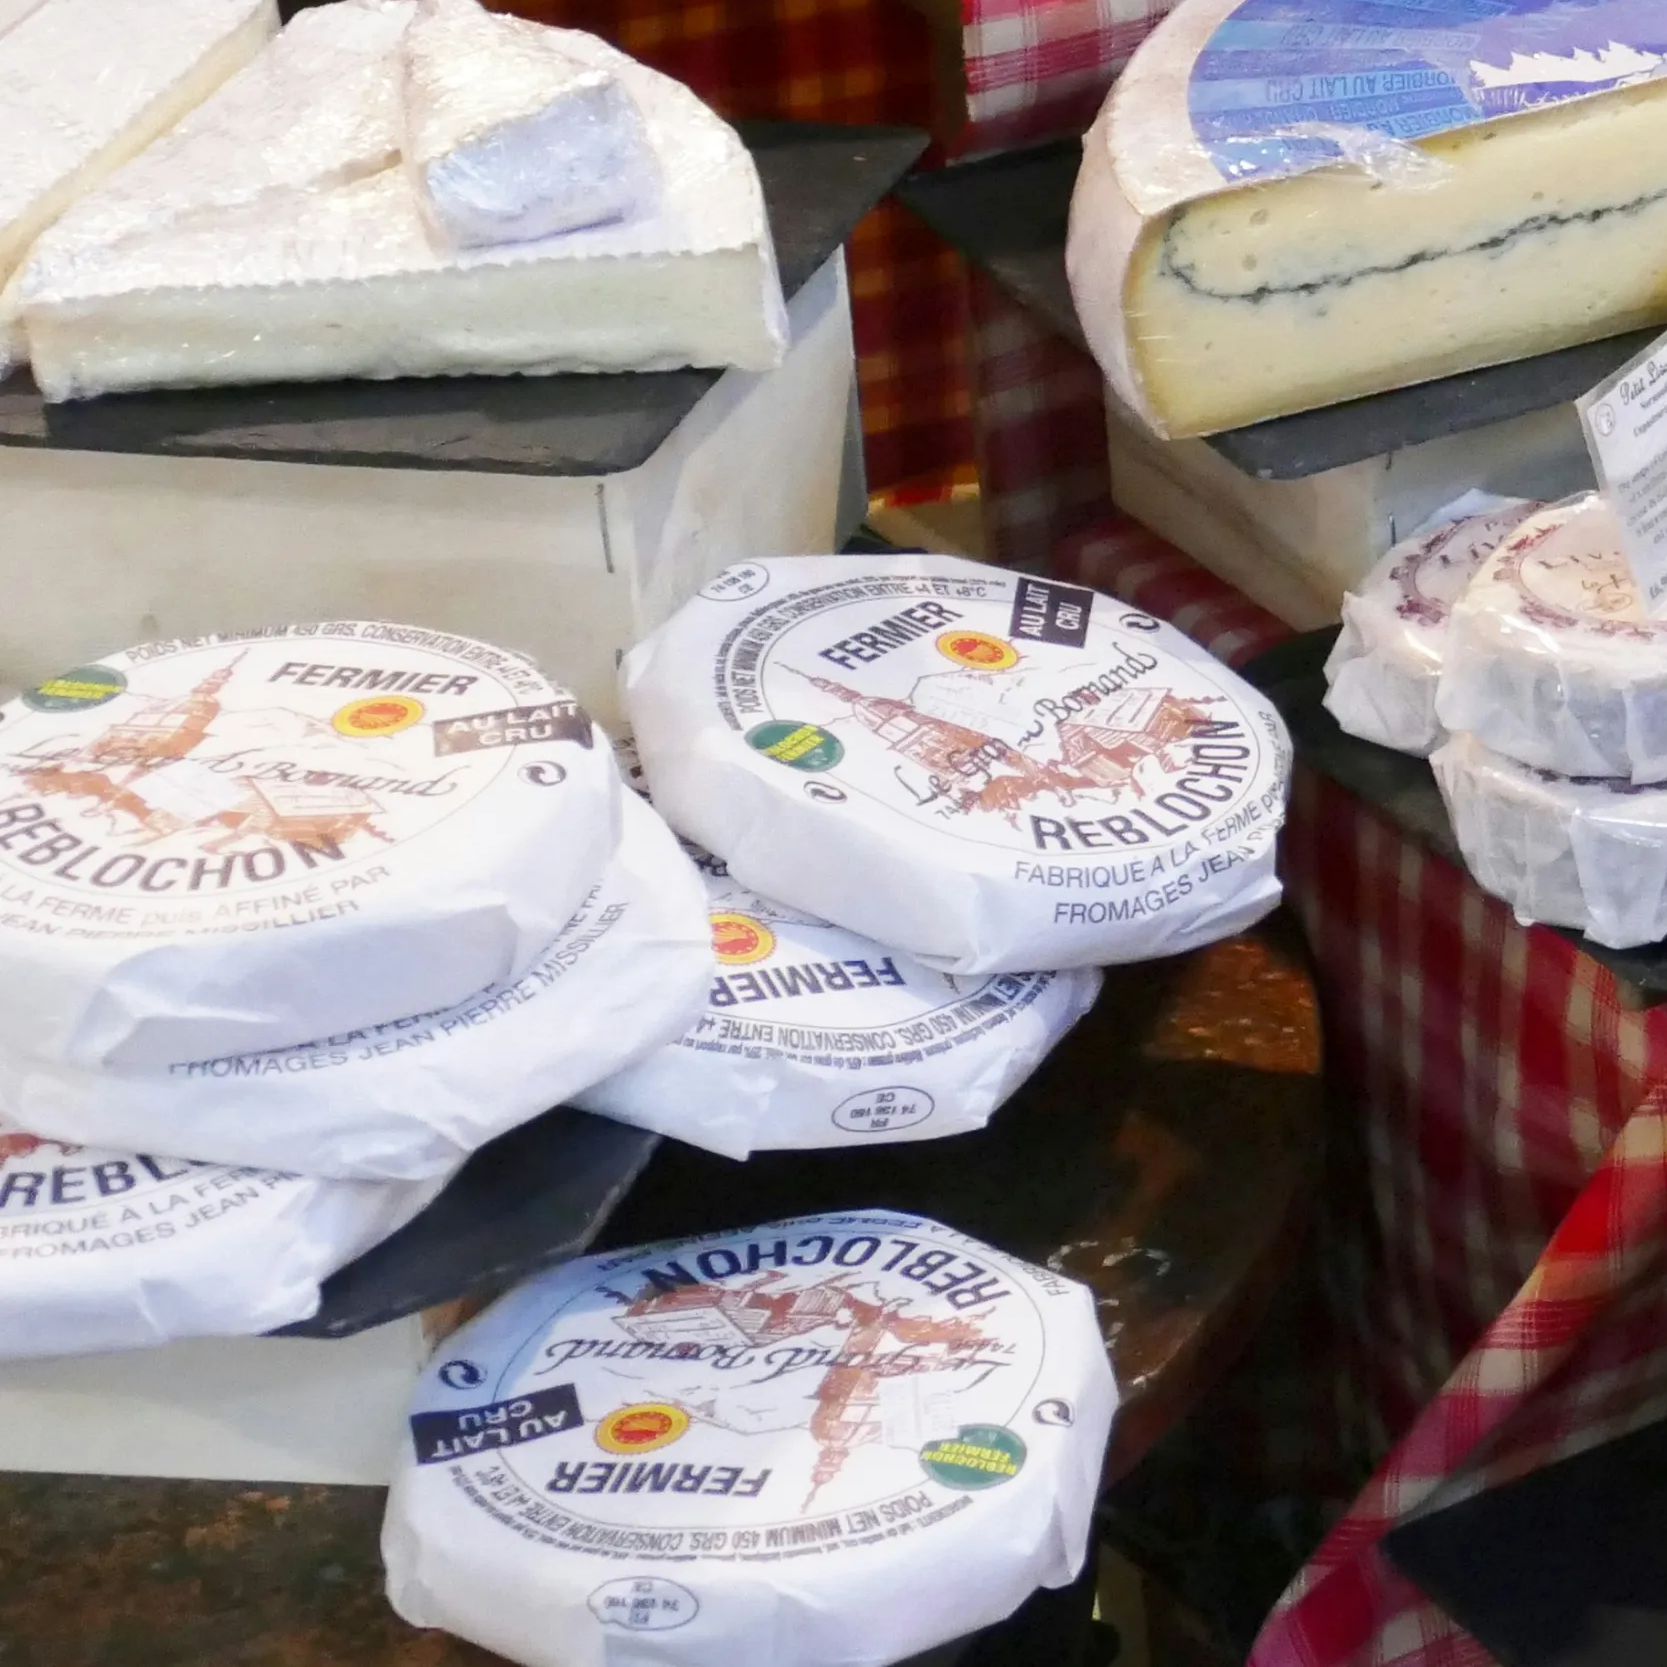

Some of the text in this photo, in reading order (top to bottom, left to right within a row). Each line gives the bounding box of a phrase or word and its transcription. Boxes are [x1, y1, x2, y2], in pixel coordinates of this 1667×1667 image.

[818, 600, 965, 670] FERMIER
[1019, 583, 1050, 637] AU LAIT
[1055, 601, 1082, 631] CRU
[268, 661, 480, 696] FERMIER
[447, 702, 578, 735] AU LAIT
[478, 725, 553, 746] CRU
[1028, 718, 1250, 851] REBLOCHON
[0, 801, 346, 893] REBLOCHON
[1169, 842, 1200, 868] LA
[36, 894, 135, 926] FERME
[213, 886, 325, 919] AFFINÉ
[330, 865, 391, 896] PAR
[1053, 873, 1193, 926] FROMAGES
[358, 1029, 436, 1063] JEAN
[440, 977, 537, 1038] PIERRE
[530, 899, 630, 991] MISSILLIER
[641, 1234, 1011, 1309] REBLOCHON
[431, 1408, 568, 1458] AU LAIT
[457, 1399, 521, 1426] CRU
[546, 1460, 773, 1499] FERMIER
